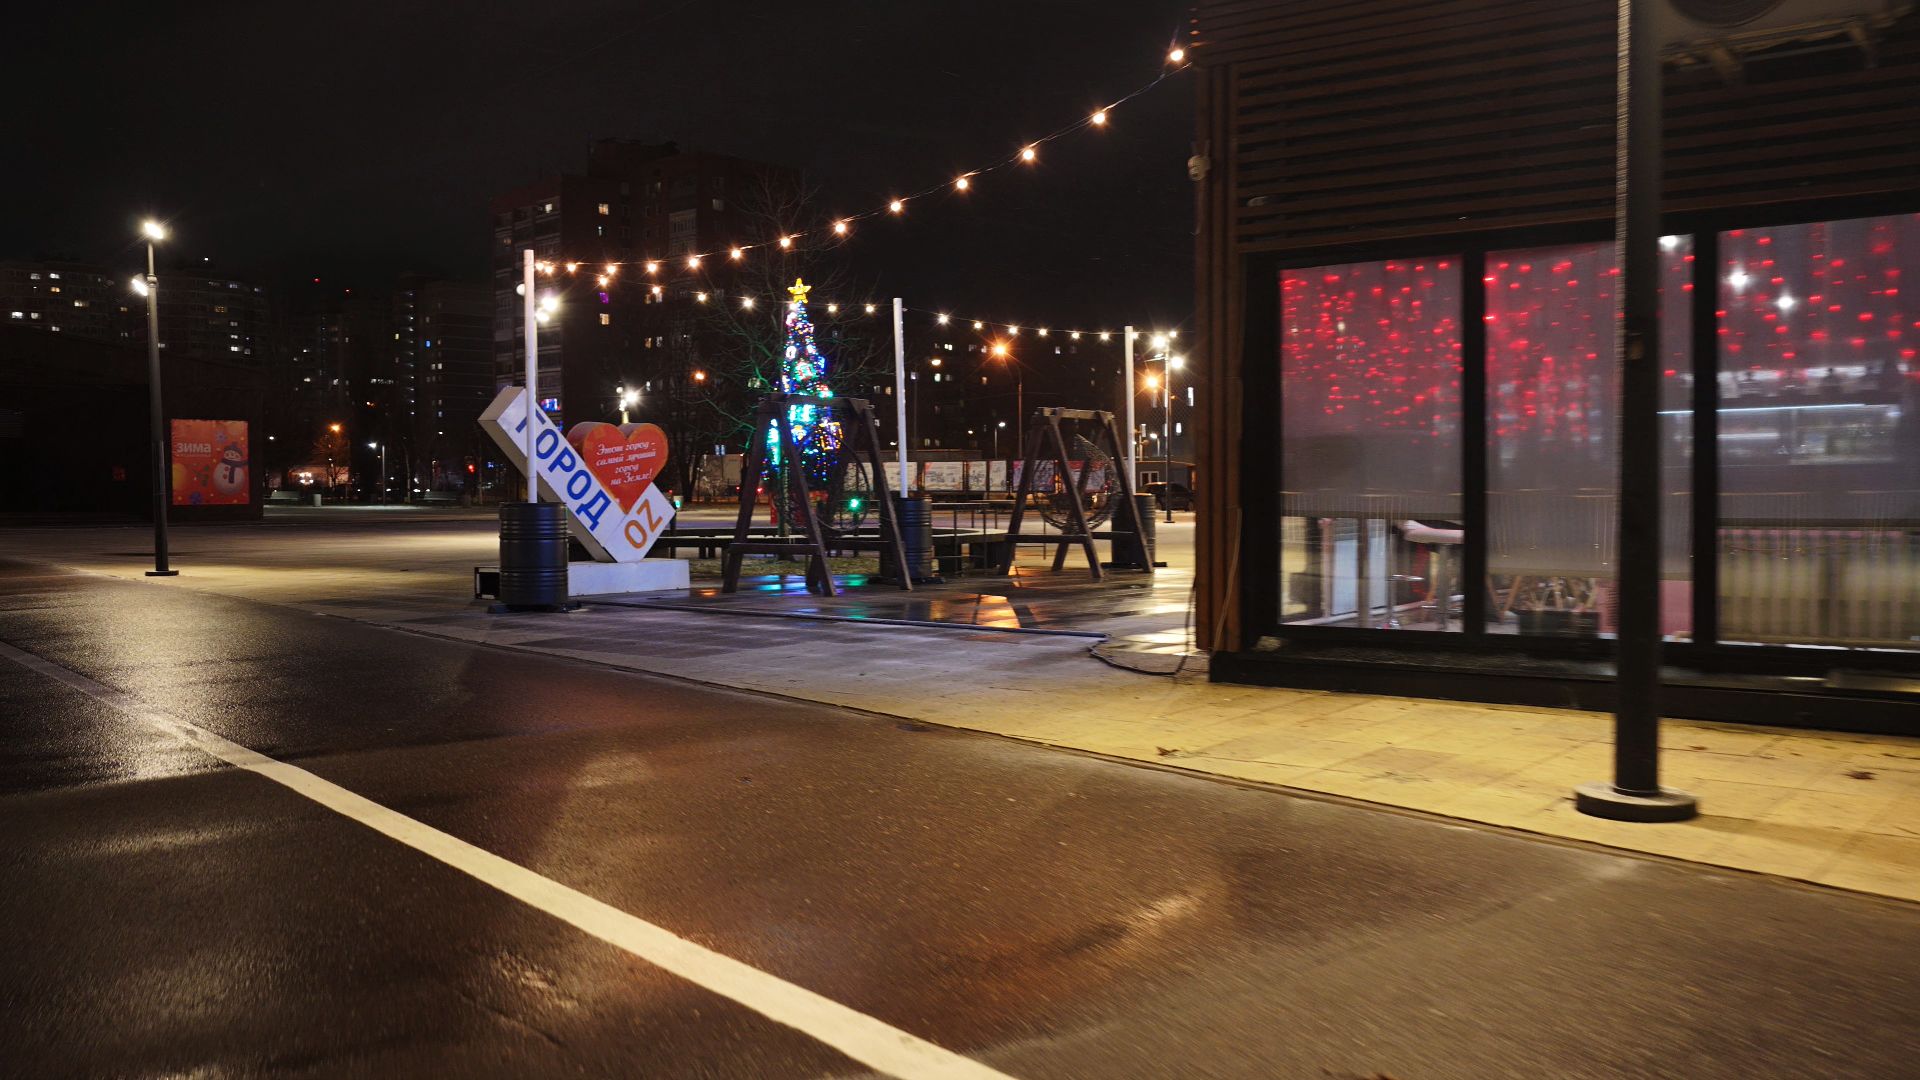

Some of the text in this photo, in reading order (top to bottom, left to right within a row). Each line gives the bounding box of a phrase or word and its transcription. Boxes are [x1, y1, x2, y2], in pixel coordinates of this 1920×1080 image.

[176, 442, 211, 453] зима
[596, 443, 624, 456] Этот
[625, 442, 650, 451] город
[596, 448, 656, 467] самый лучший
[516, 409, 611, 531] ГОРОД
[610, 468, 653, 486] на Земле!
[615, 464, 639, 474] город
[624, 498, 663, 549] OZ
